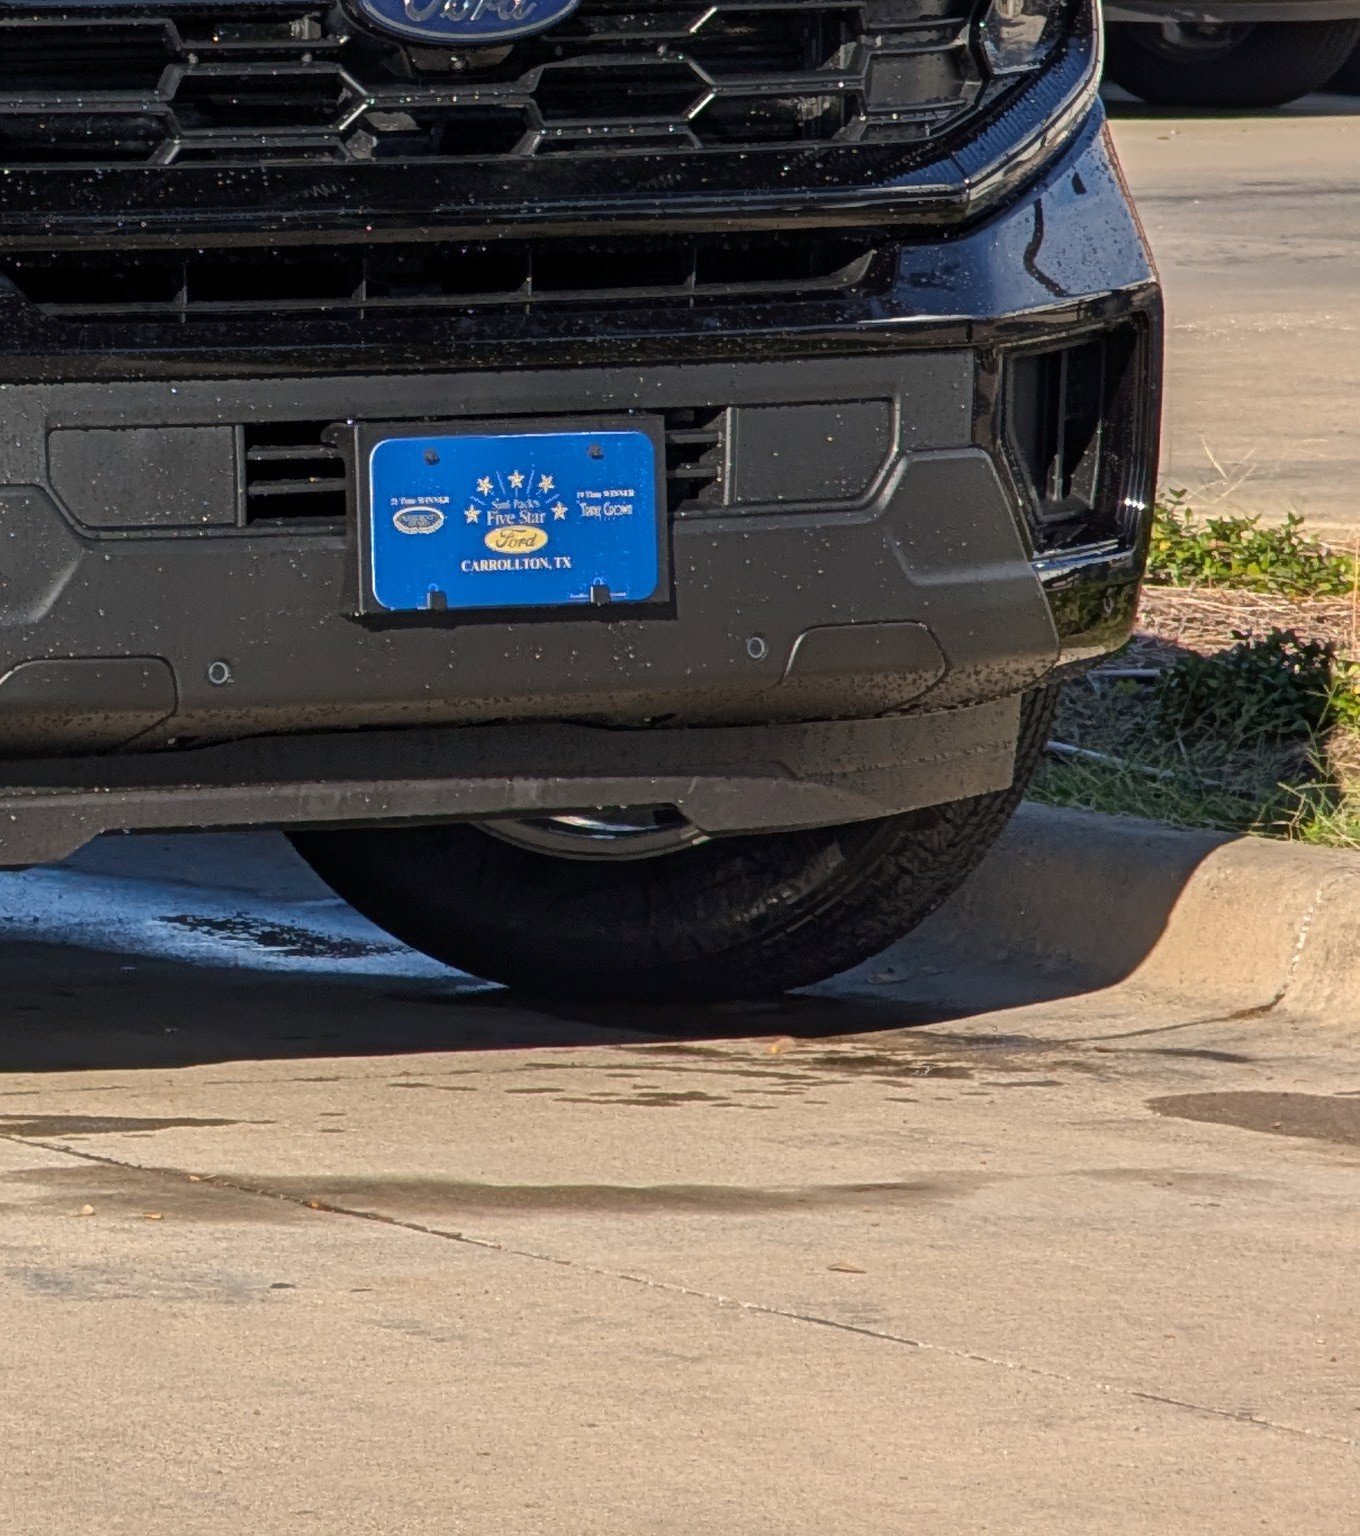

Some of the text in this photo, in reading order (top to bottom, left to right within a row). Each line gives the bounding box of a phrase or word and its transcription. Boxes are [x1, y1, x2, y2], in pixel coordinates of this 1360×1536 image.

[487, 509, 547, 526] Five Star
[496, 529, 538, 549] Ford
[461, 556, 573, 573] CARROLLTON, TX
